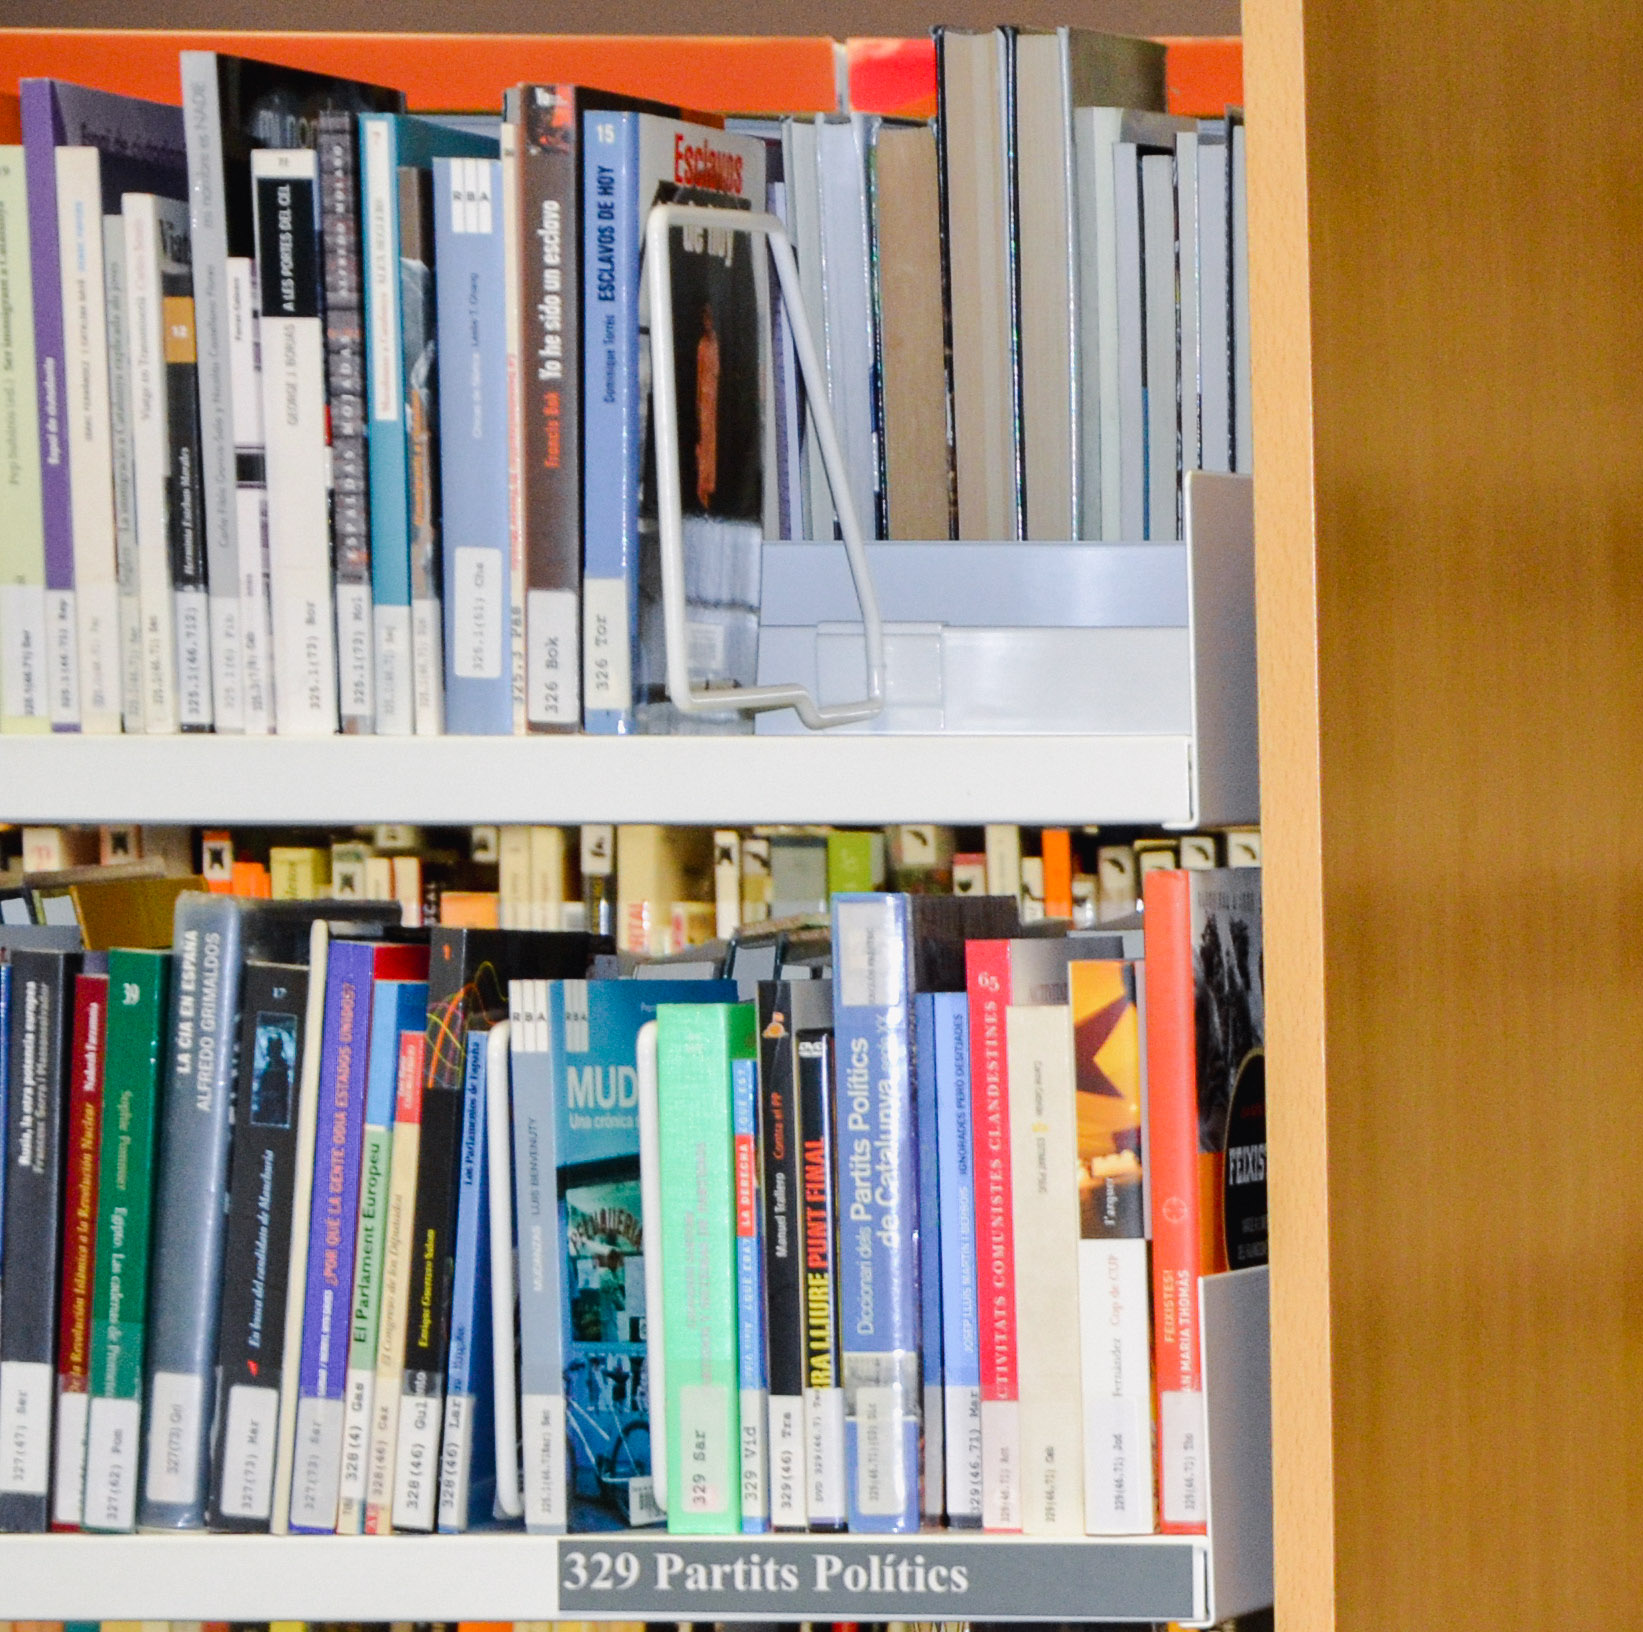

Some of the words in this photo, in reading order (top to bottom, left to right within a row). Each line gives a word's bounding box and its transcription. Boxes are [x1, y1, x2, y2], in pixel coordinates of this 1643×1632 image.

[596, 123, 615, 143] 15
[596, 166, 614, 195] HOY
[597, 202, 615, 219] DE
[536, 200, 561, 265] esclavo
[541, 269, 561, 291] un
[597, 226, 615, 301] ESCLAVOS
[537, 295, 561, 330] sido
[537, 335, 561, 357] he
[537, 361, 562, 379] Yo
[178, 996, 194, 1016] EN
[198, 932, 221, 1031] GRIMALDOS
[176, 1054, 193, 1074] LA
[196, 1036, 214, 1111] ALFREDO
[846, 1038, 871, 1131] Polítics
[984, 1001, 1002, 1150] CLANDESTINES
[363, 1143, 384, 1219] Europeu
[805, 1137, 826, 1202] FINAL
[849, 1139, 873, 1220] Partits
[806, 1207, 828, 1268] PUNT
[855, 1227, 872, 1258] dels
[355, 1222, 374, 1320] Parlament
[856, 1262, 875, 1335] Diccionari
[353, 1327, 368, 1342] El
[808, 1273, 830, 1350] LLIURE
[563, 1552, 640, 1591] 329
[653, 1552, 799, 1591] Partits
[812, 1553, 969, 1592] Polítics
